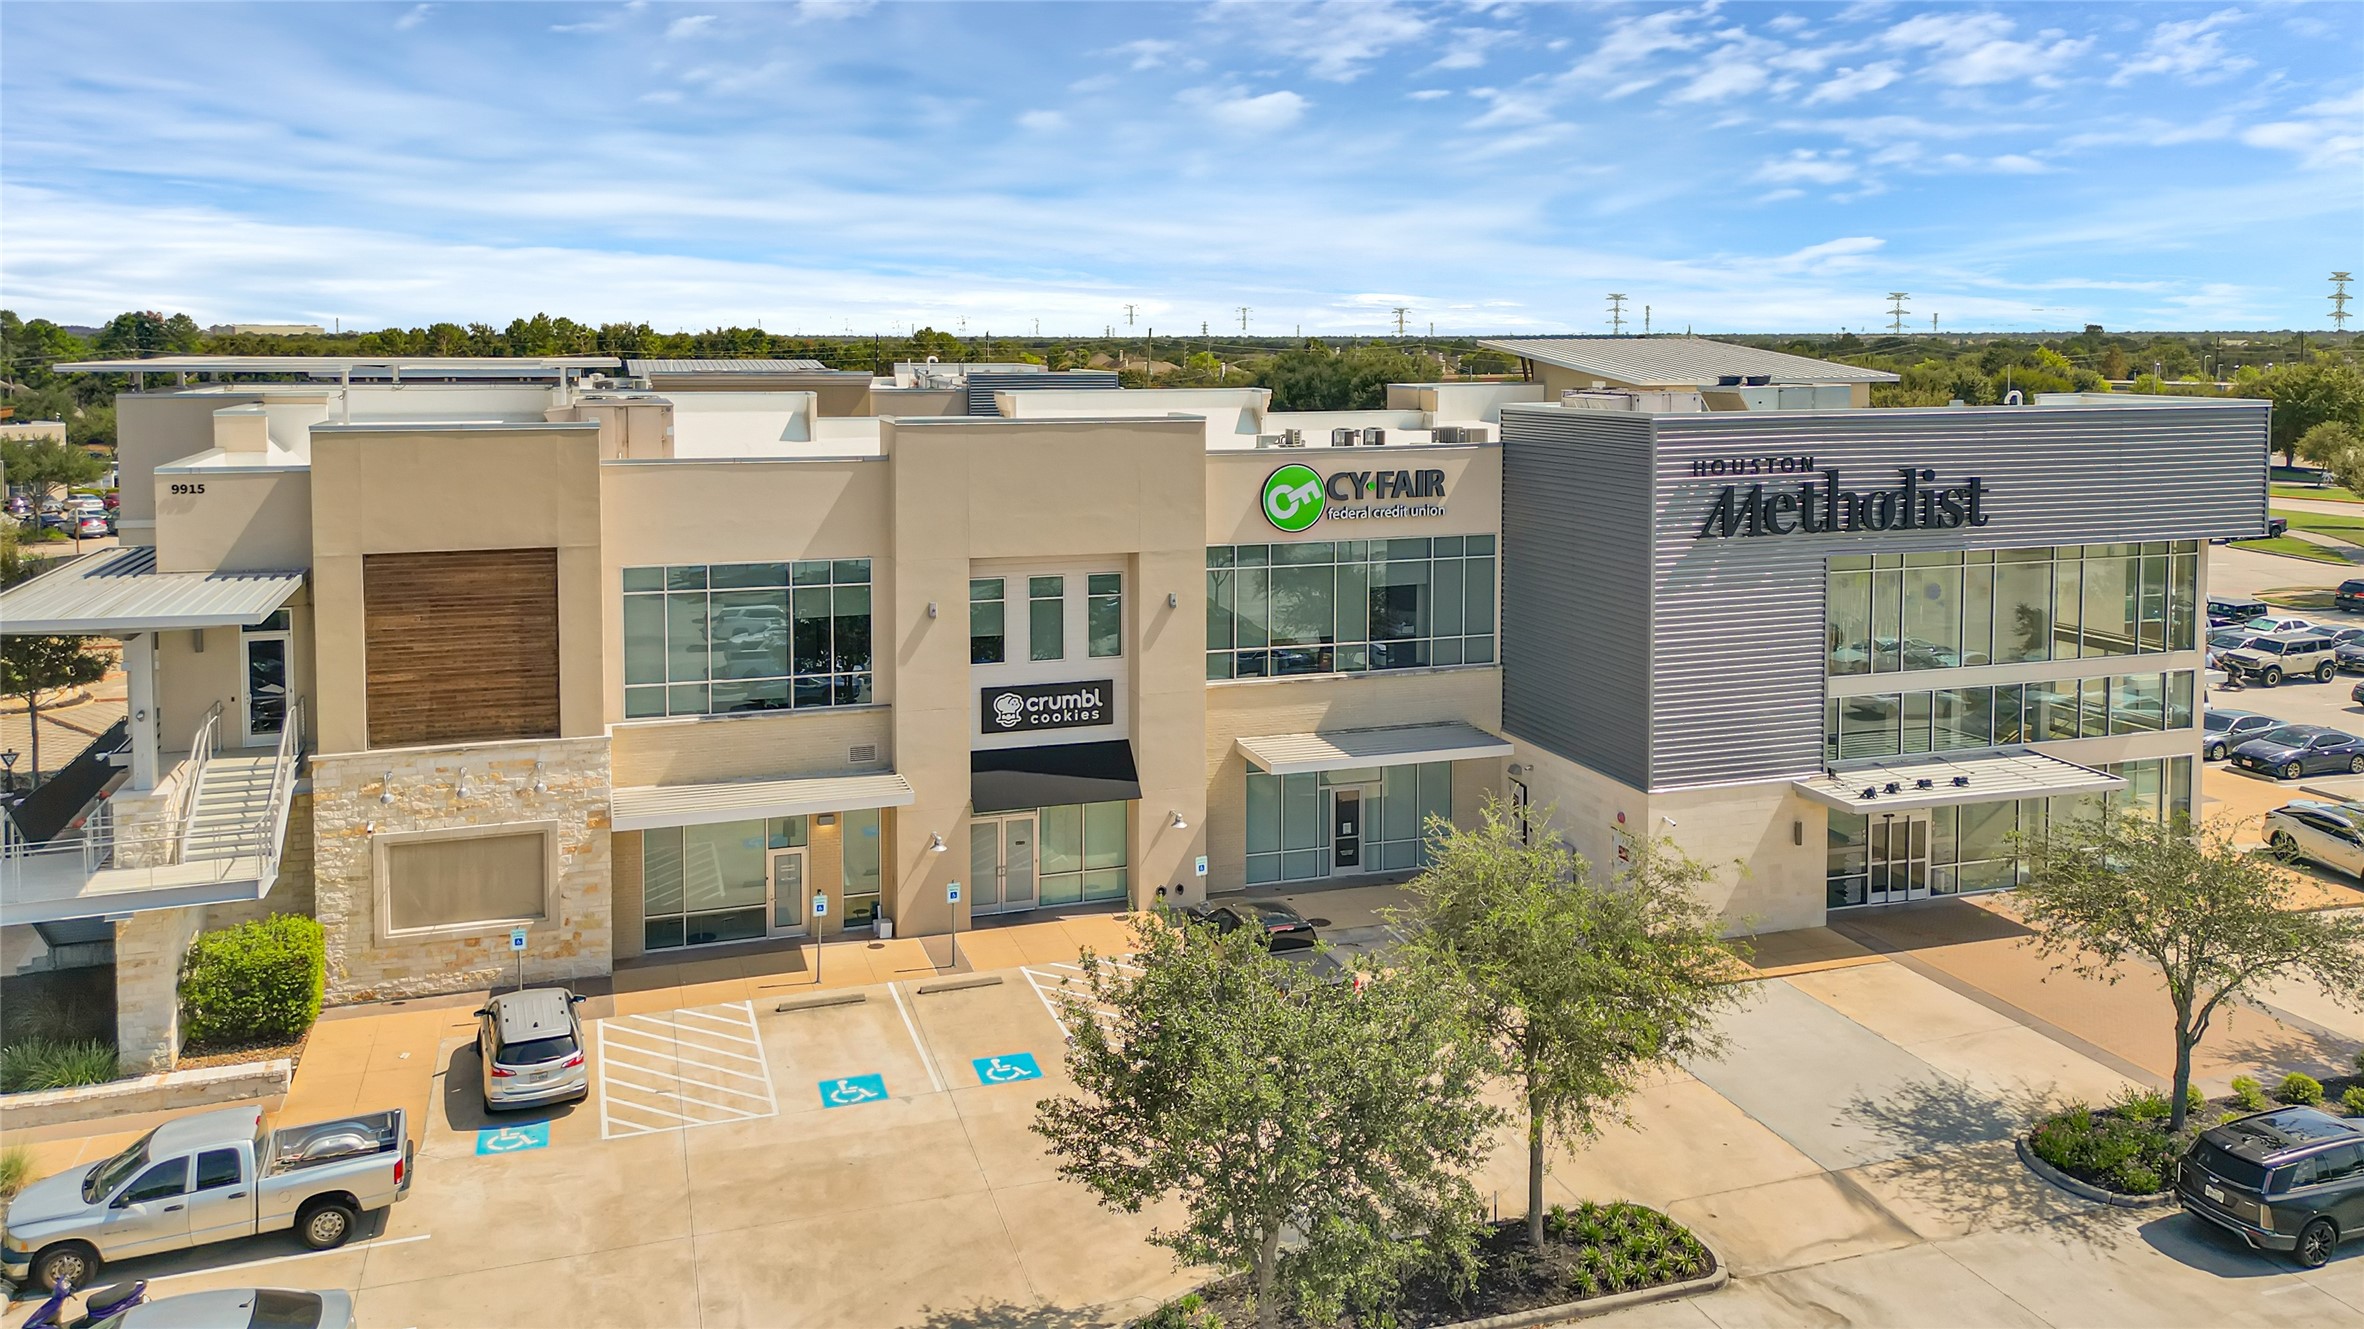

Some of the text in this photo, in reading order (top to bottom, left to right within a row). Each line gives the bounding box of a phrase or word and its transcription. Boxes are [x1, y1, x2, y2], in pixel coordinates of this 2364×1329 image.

[1692, 456, 1814, 477] HOUSTON
[171, 484, 205, 495] 9915
[1327, 504, 1446, 520] federal credit union
[1695, 468, 1990, 539] Methodist
[1026, 688, 1104, 712] crumbl
[1030, 710, 1100, 724] cookies
